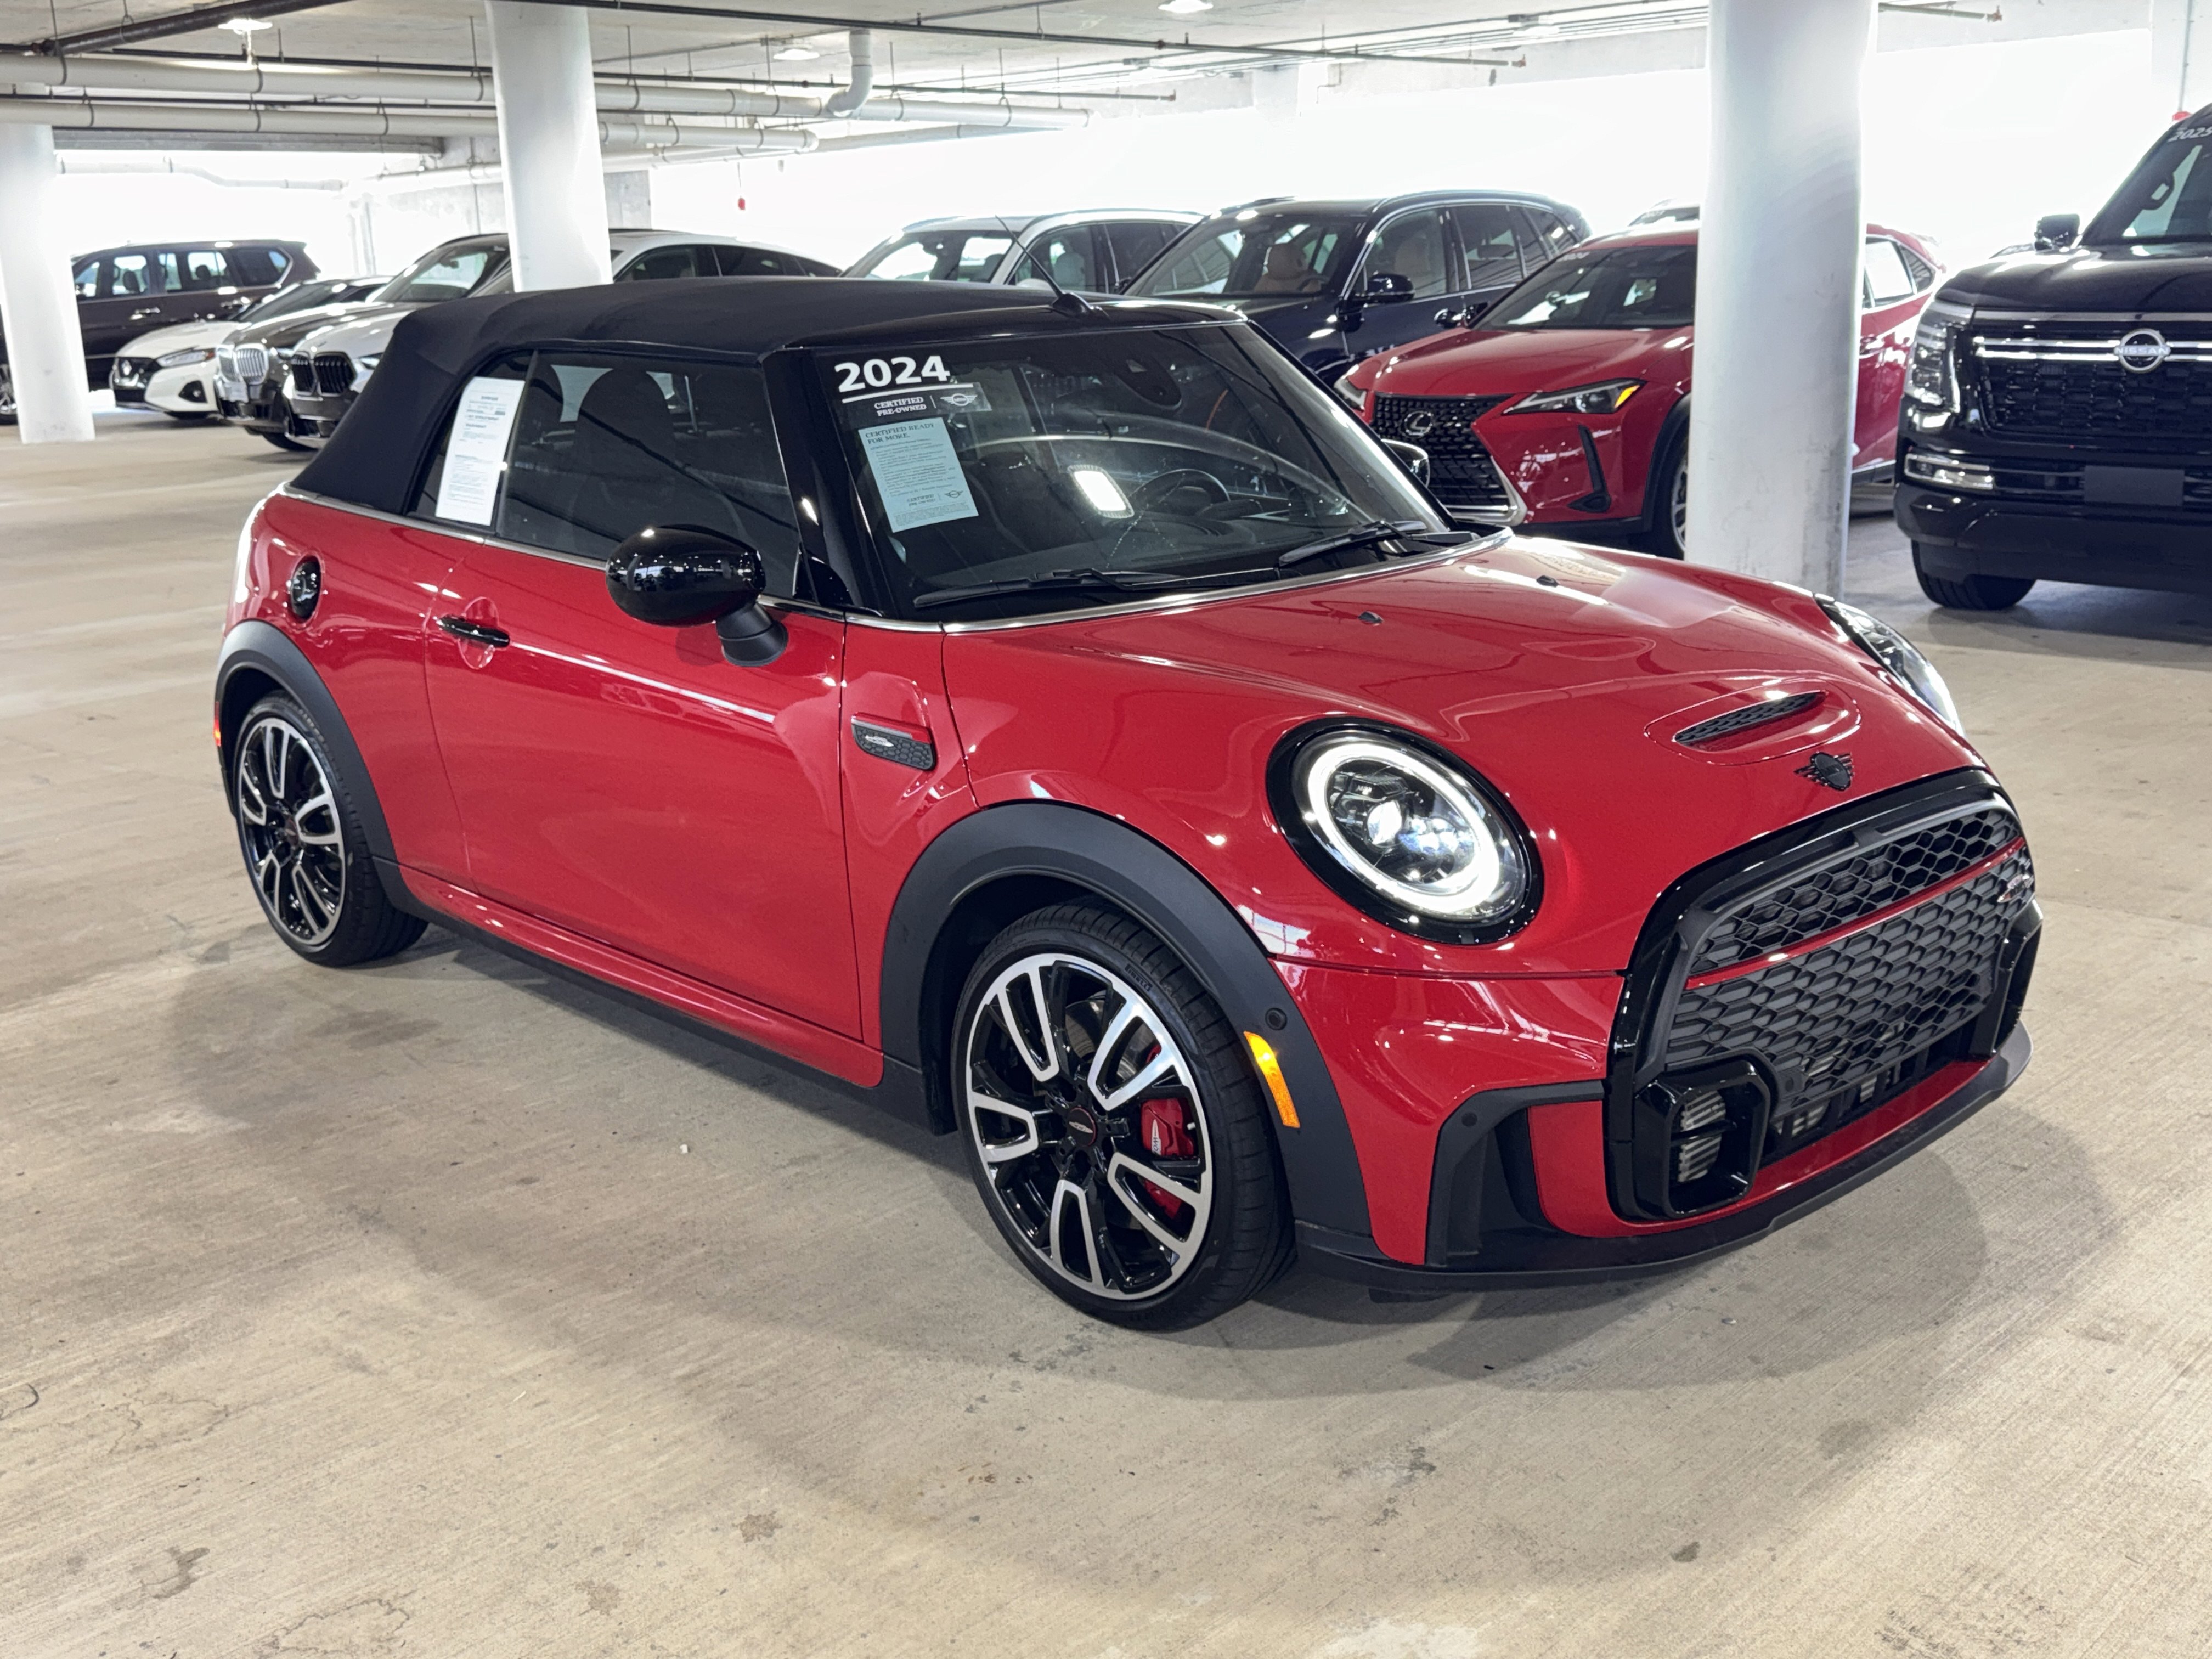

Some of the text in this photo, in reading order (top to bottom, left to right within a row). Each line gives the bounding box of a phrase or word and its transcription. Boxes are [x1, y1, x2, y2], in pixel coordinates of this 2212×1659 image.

[2168, 126, 2212, 142] 2025
[2116, 346, 2169, 356] NISSAN
[834, 355, 950, 393] 2024
[873, 396, 924, 410] CERTIFIED
[876, 404, 927, 417] PRE-OWNED
[865, 422, 934, 438] CERTIFIED READY
[867, 437, 883, 445] FOR
